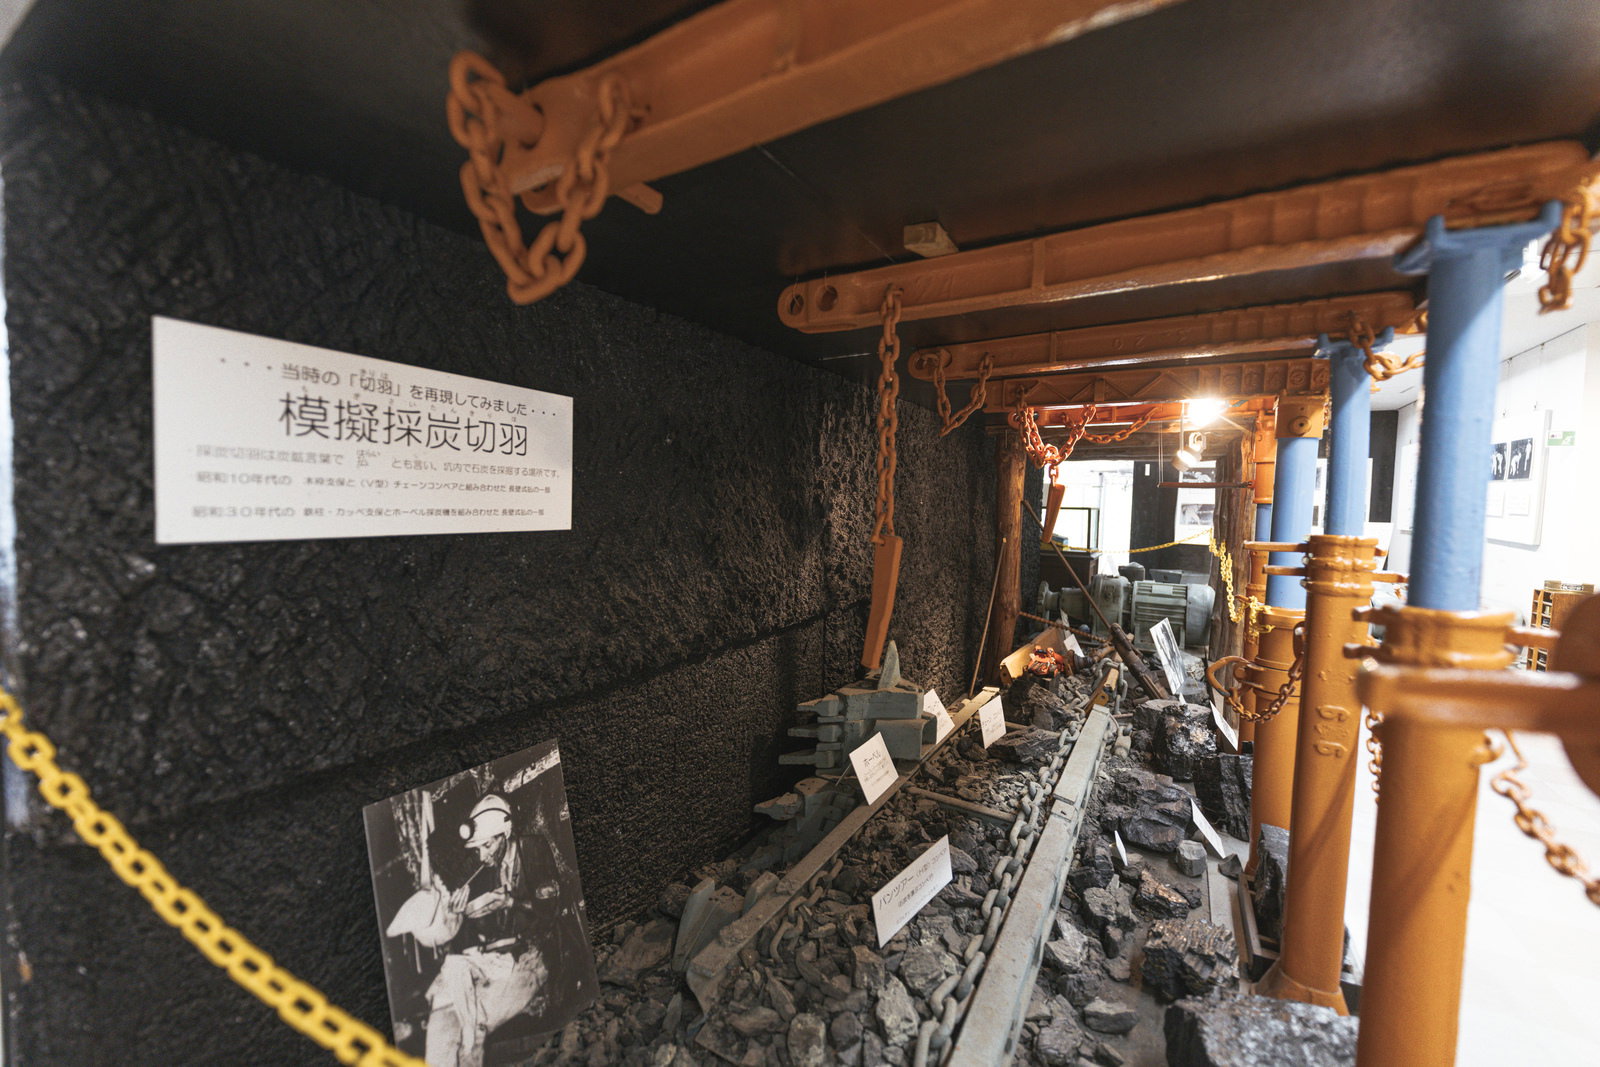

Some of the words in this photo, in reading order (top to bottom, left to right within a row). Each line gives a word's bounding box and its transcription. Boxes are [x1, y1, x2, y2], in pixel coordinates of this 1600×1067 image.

[278, 391, 528, 456] 模擬採炭切羽
